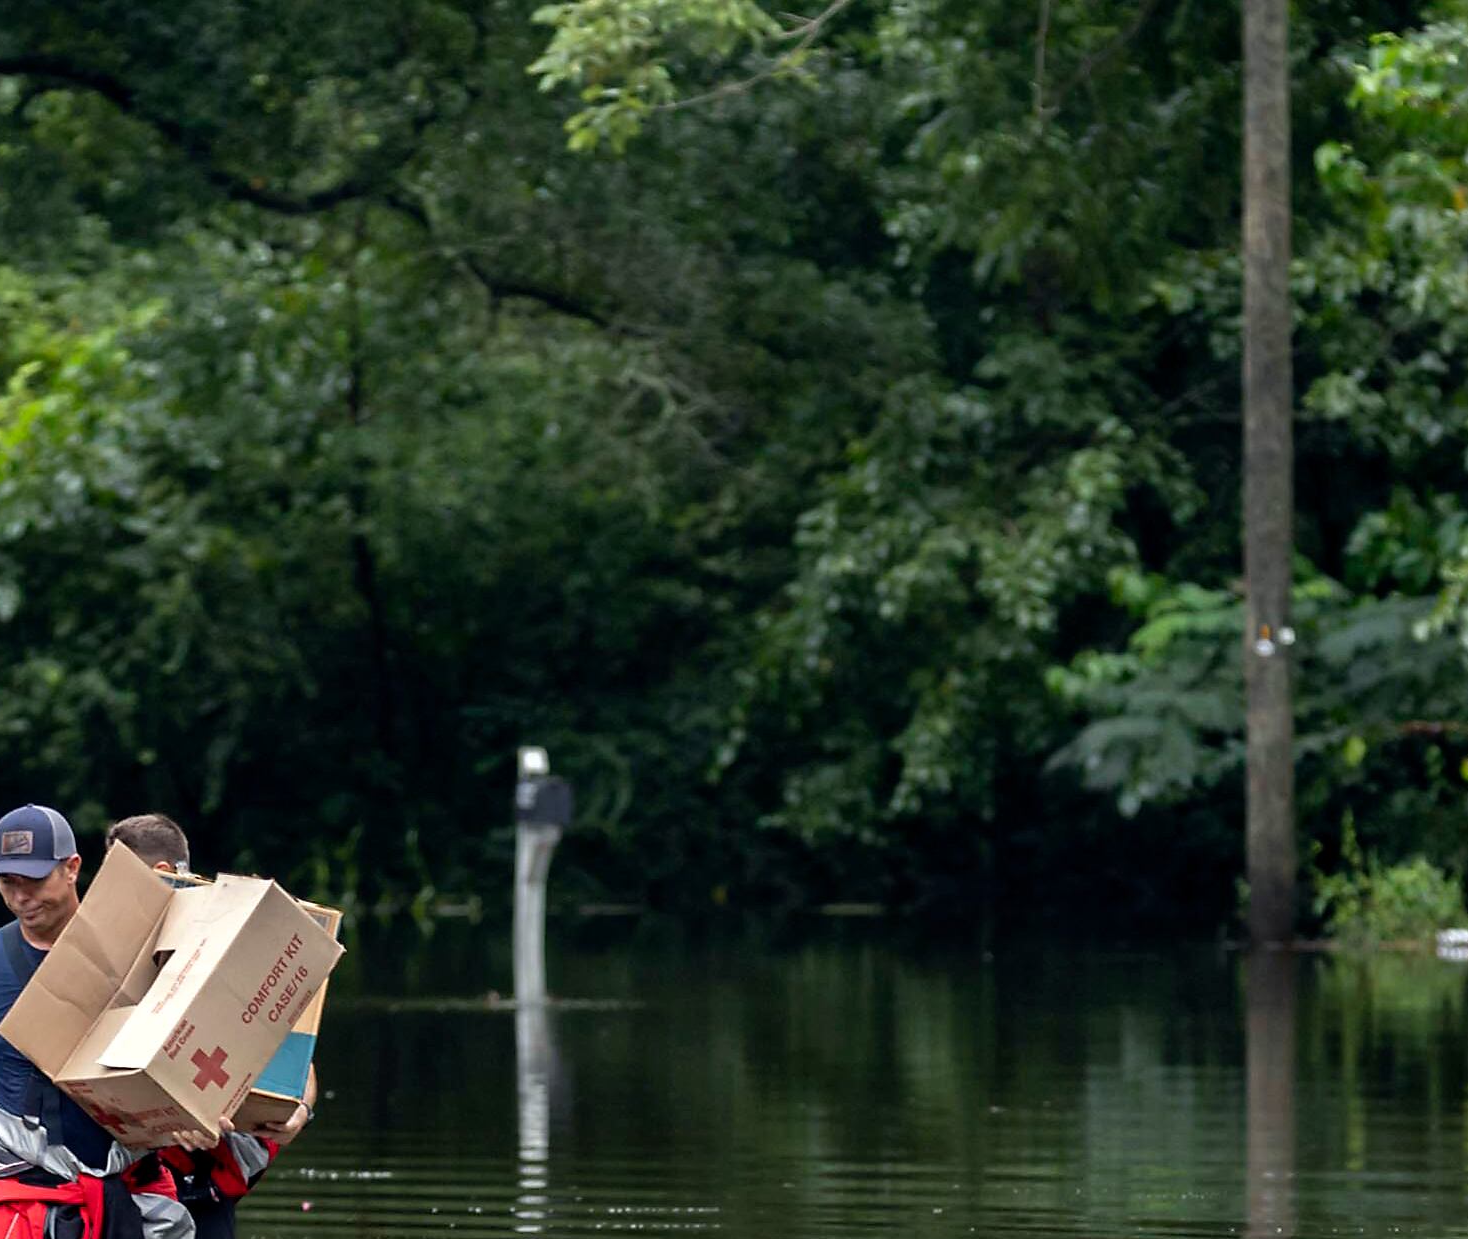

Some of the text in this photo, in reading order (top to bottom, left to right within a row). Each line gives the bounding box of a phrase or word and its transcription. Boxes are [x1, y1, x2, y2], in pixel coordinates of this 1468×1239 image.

[241, 957, 288, 1024] COMFORT
[284, 933, 303, 960] KIT
[268, 965, 308, 1023] CASE/16
